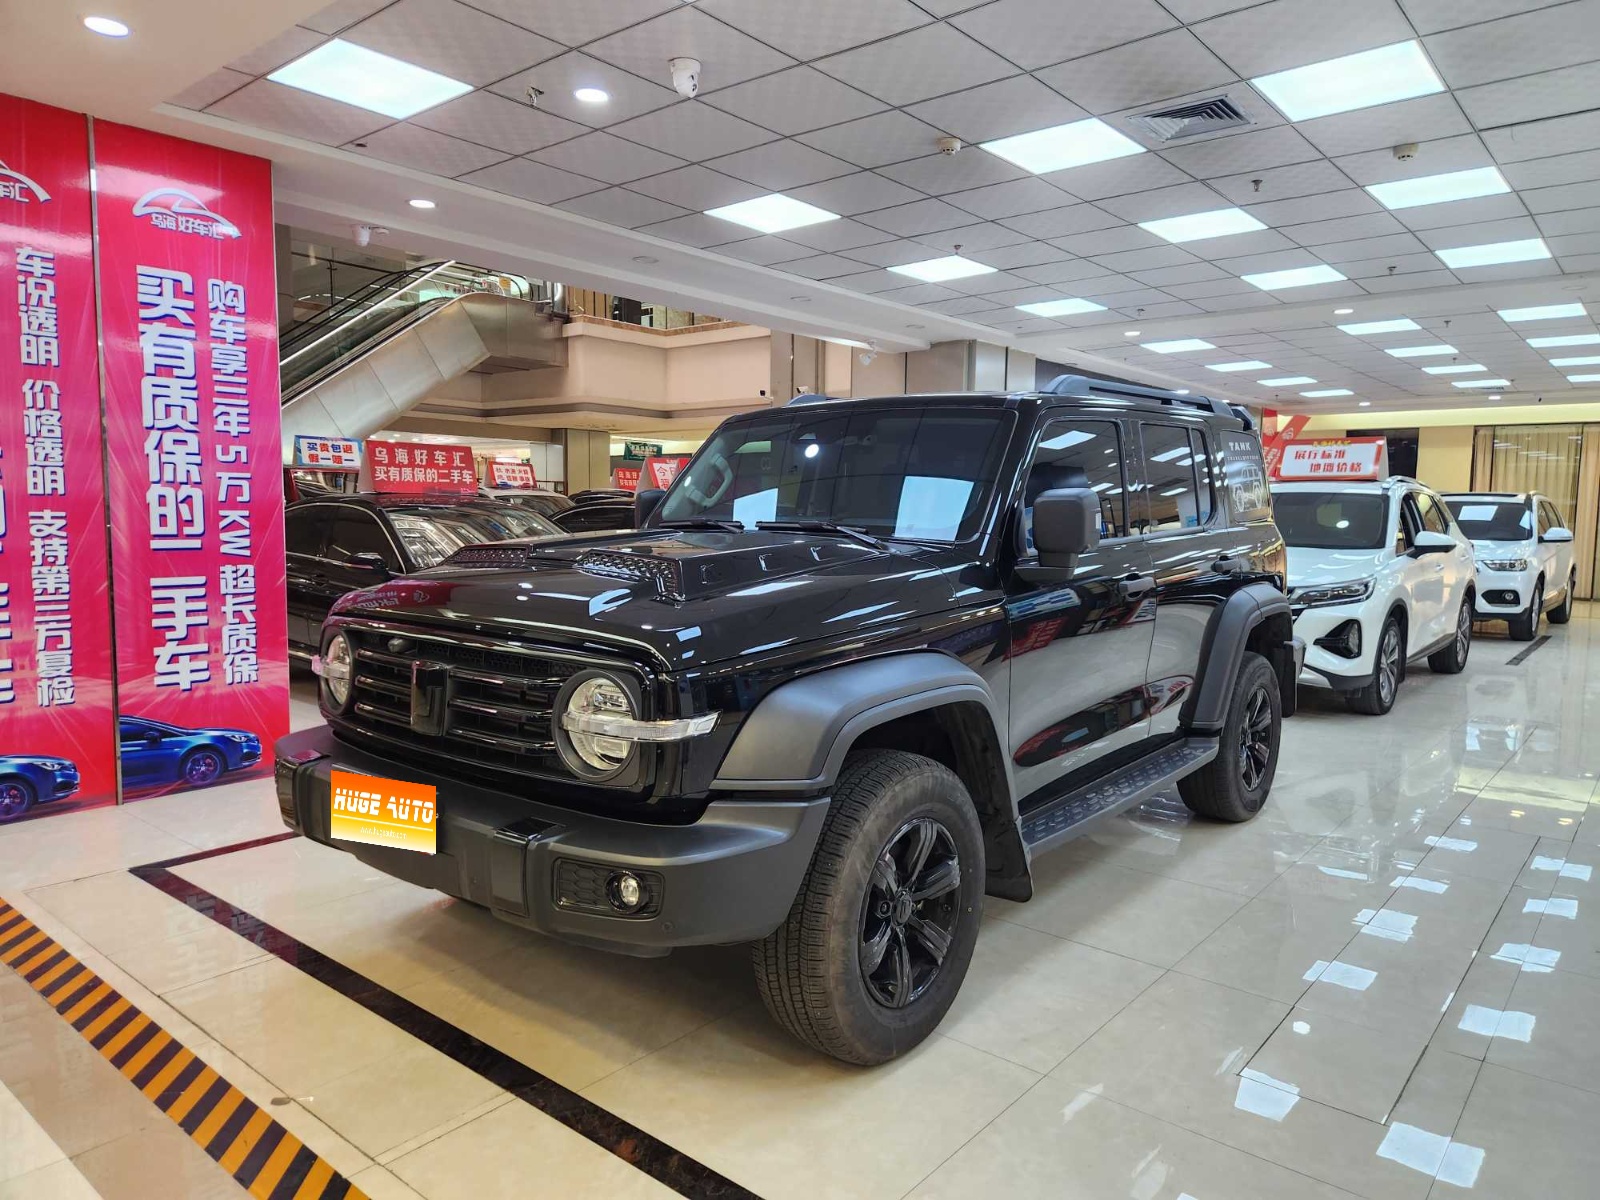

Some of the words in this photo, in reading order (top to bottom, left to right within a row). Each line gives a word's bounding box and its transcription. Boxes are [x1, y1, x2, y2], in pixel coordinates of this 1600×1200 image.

[15, 246, 59, 367] 车况透明
[22, 378, 66, 496] 价格透明
[136, 263, 211, 691] 买有质保的二手车
[374, 447, 466, 468] 乌海好车汇
[374, 466, 474, 485] 买有质保的二手车
[1228, 441, 1251, 451] TANK
[28, 508, 76, 707] 支持第三方复检
